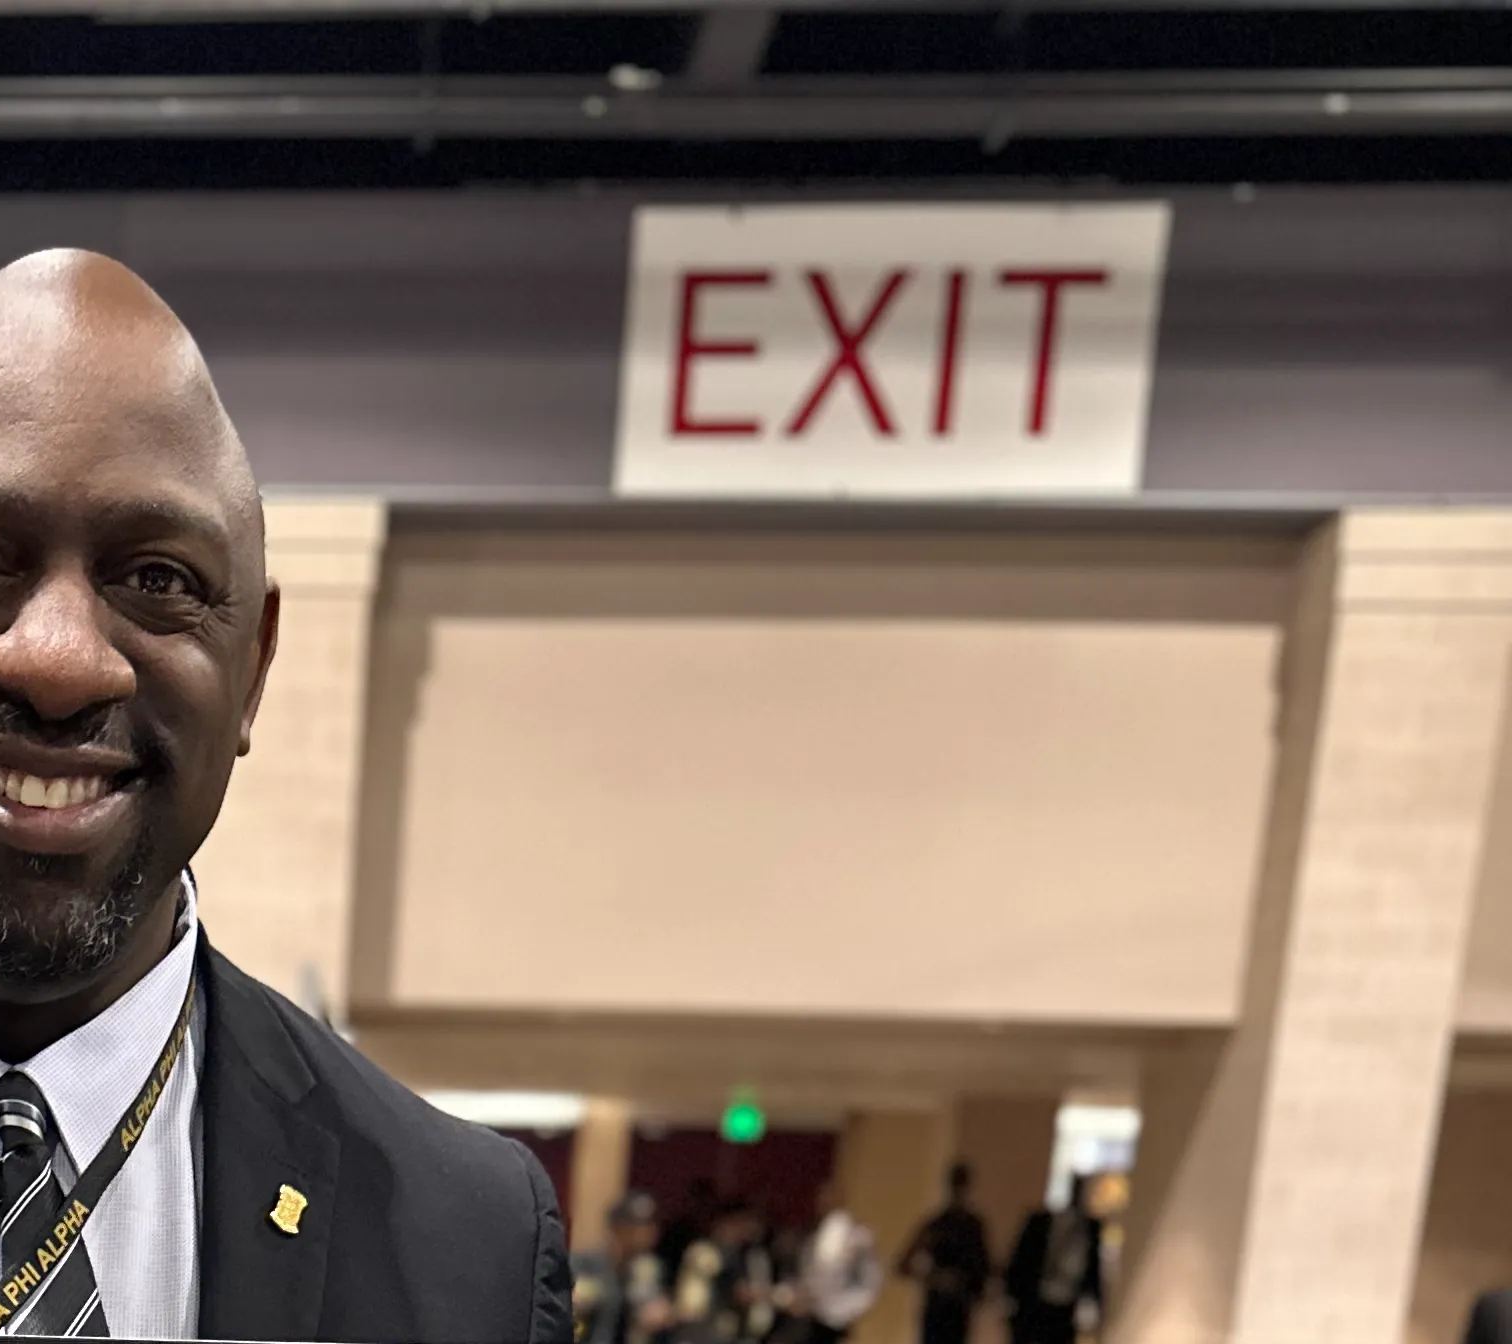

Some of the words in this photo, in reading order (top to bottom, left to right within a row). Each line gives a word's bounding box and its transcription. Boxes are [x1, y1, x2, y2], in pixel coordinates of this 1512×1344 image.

[668, 268, 1108, 440] EXIT
[120, 1079, 161, 1152] ALPHA
[159, 1039, 178, 1083] PHI
[2, 1261, 42, 1307] PHI
[36, 1199, 90, 1273] ALPHA
